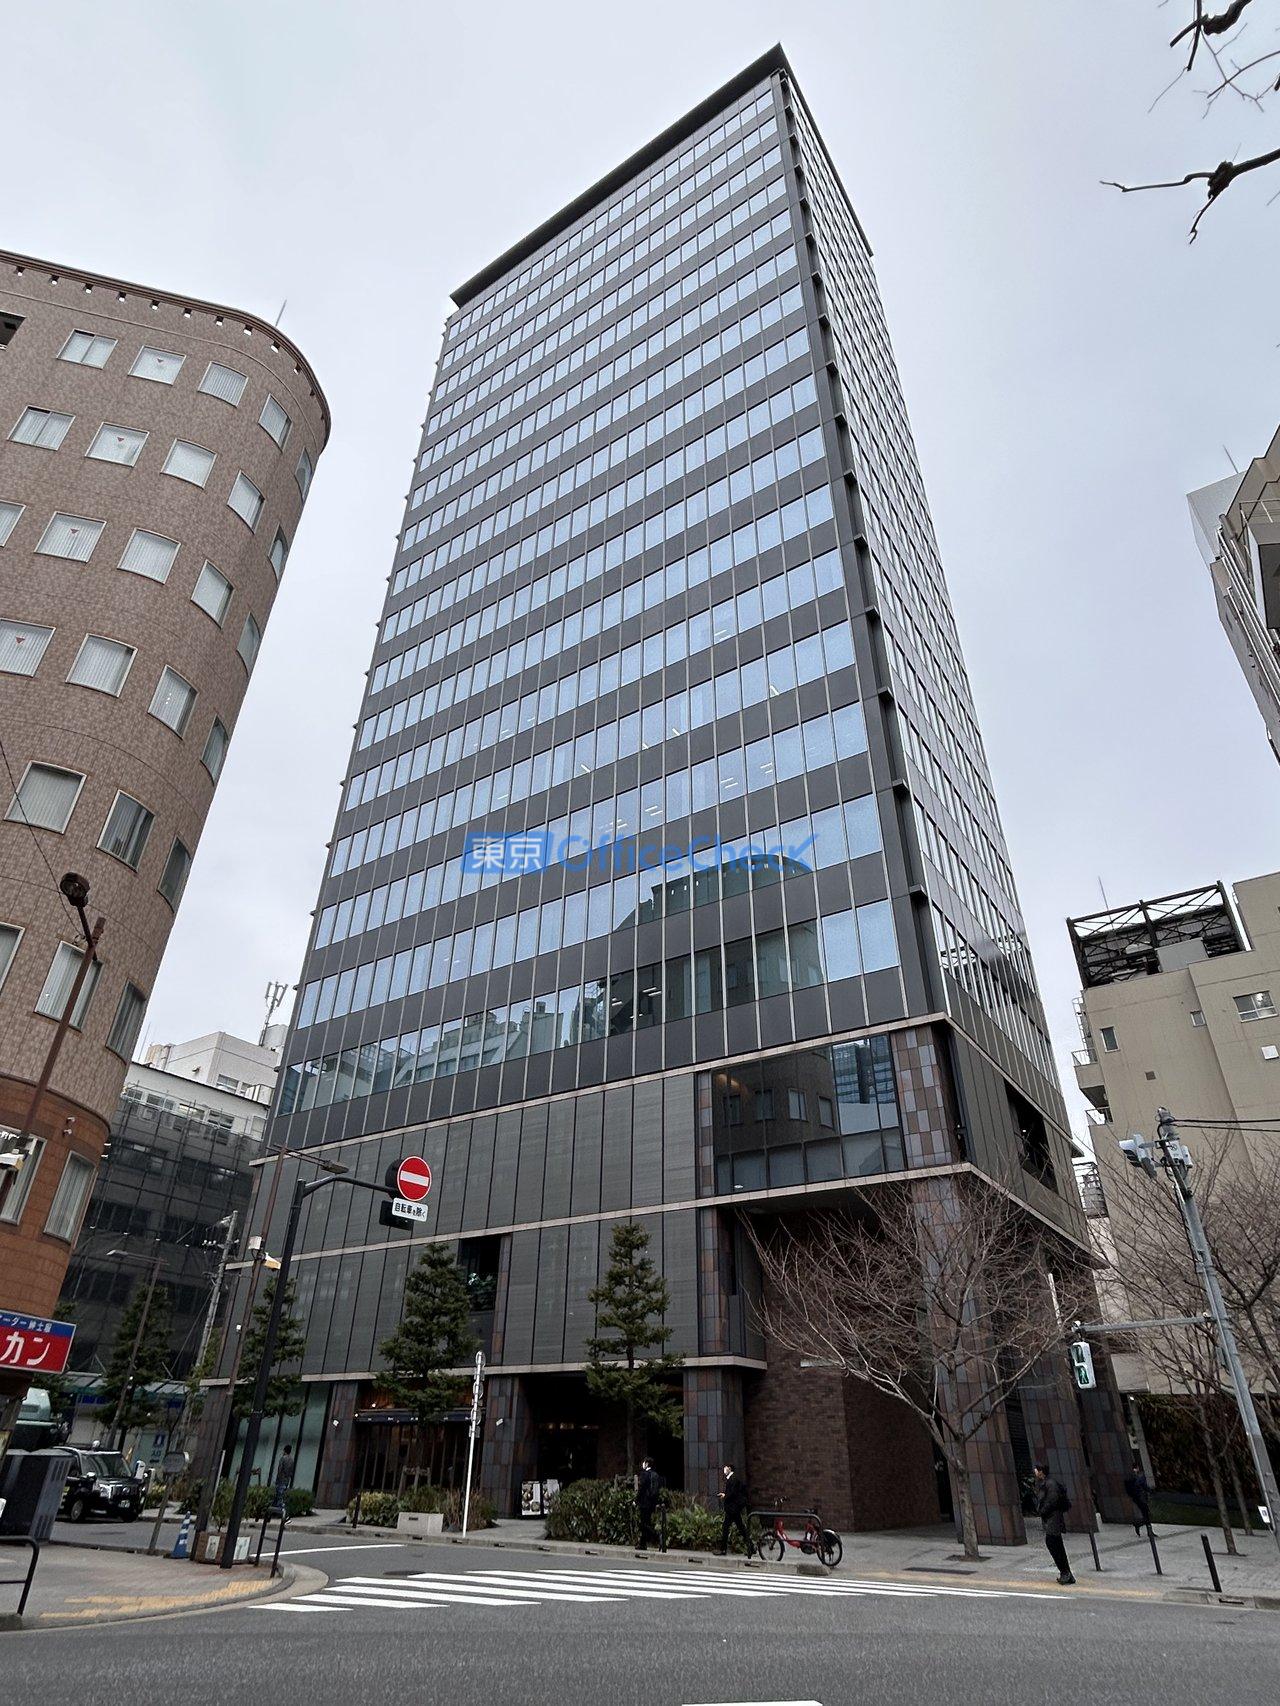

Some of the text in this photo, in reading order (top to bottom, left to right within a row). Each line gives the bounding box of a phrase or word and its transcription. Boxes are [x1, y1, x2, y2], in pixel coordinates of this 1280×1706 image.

[0, 1315, 52, 1333] ーダー紳士服
[0, 1331, 51, 1366] カン
